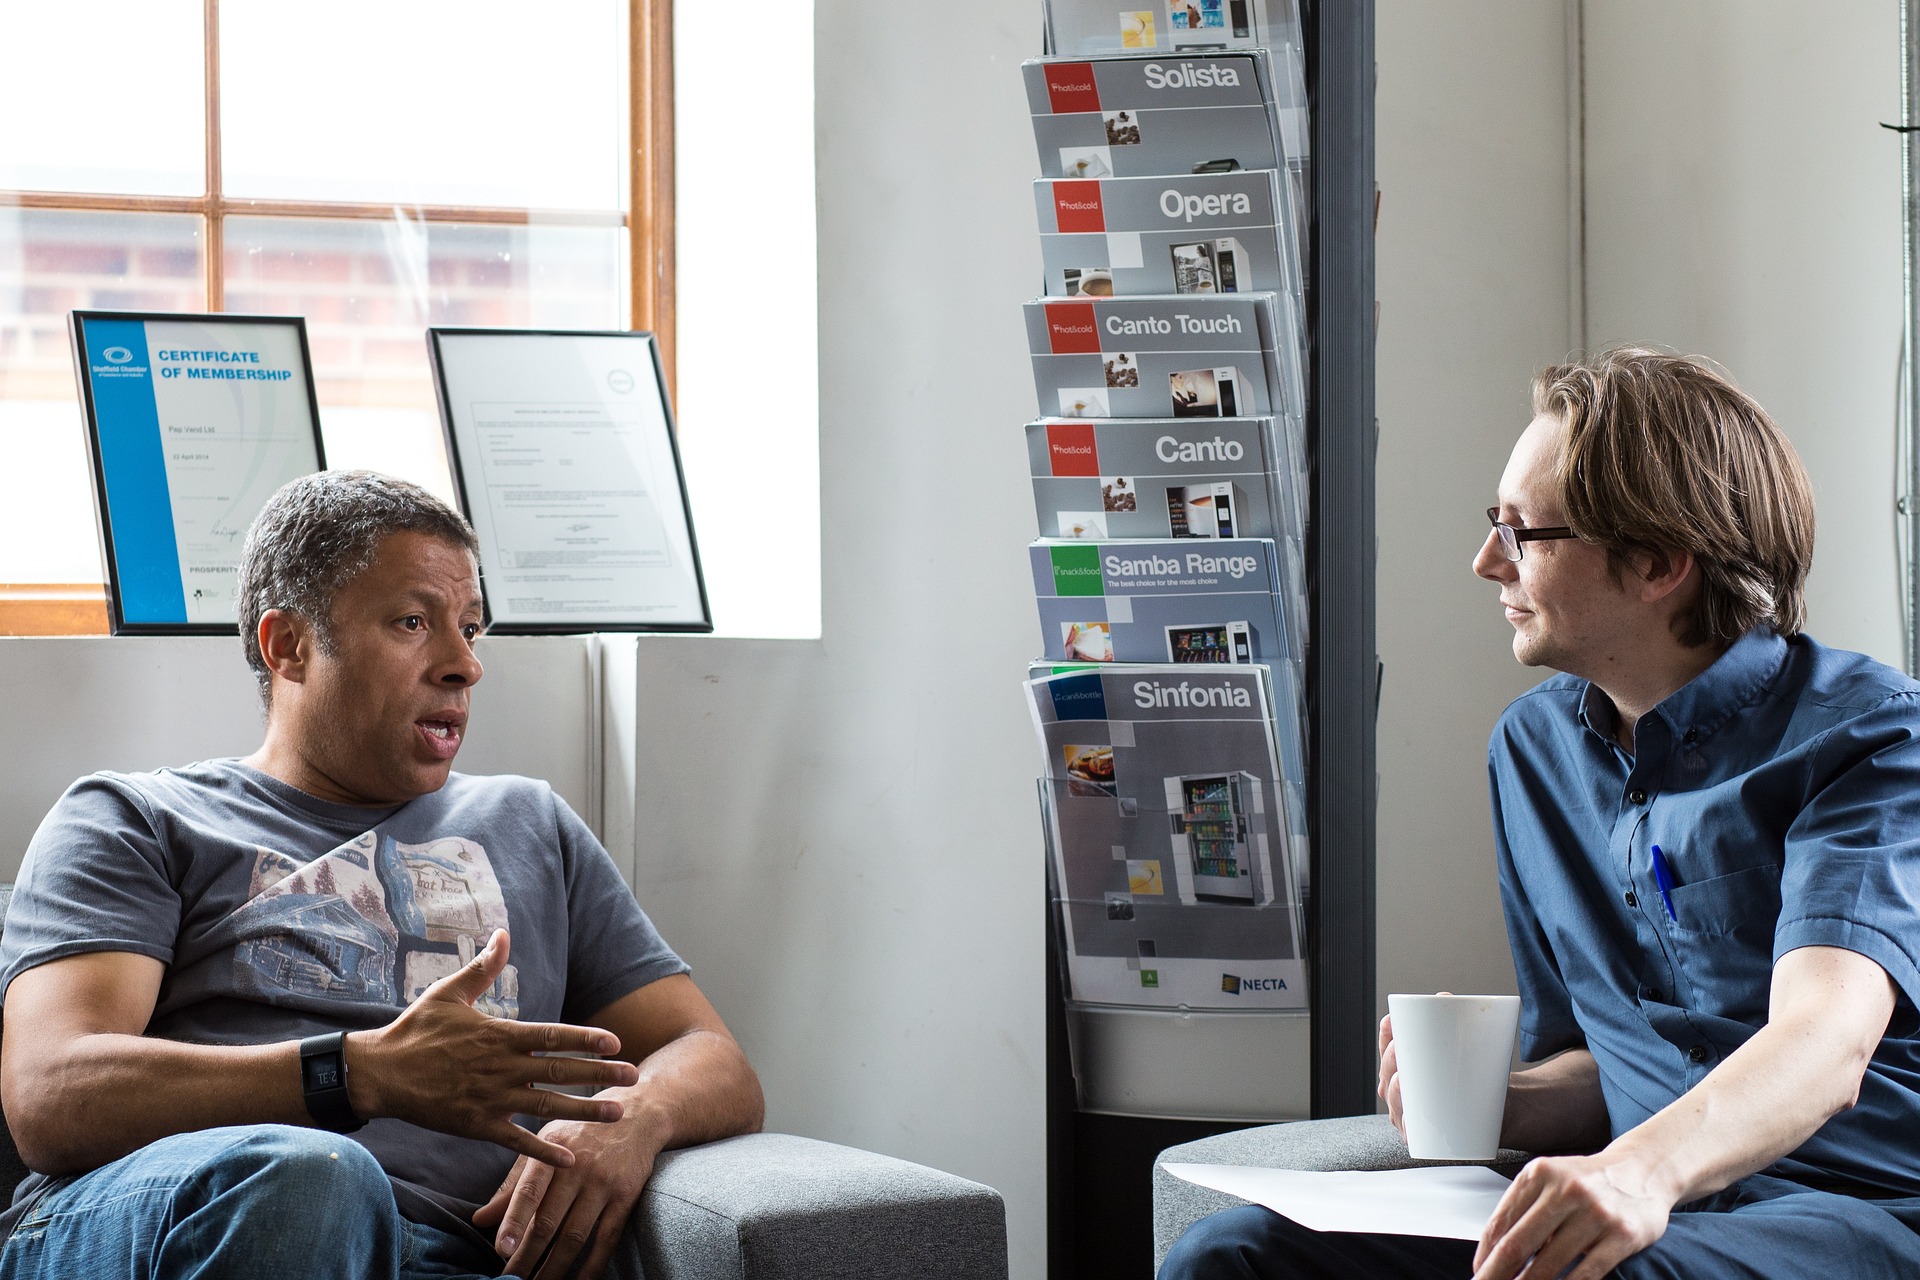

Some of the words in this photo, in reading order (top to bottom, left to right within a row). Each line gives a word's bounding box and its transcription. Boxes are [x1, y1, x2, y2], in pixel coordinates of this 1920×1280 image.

[1145, 63, 1240, 89] Solista
[1160, 190, 1251, 222] Opera
[1106, 315, 1171, 335] Canto
[1175, 315, 1242, 334] Touch
[158, 350, 260, 363] CERTIFICATE
[161, 368, 181, 378] OF
[187, 368, 292, 381] MEMBERSHIP
[1155, 436, 1244, 463] Canto
[1105, 555, 1181, 577] Samba
[1186, 554, 1257, 579] Range
[1133, 682, 1251, 709] Sinfonia
[1243, 979, 1287, 991] NECTA
